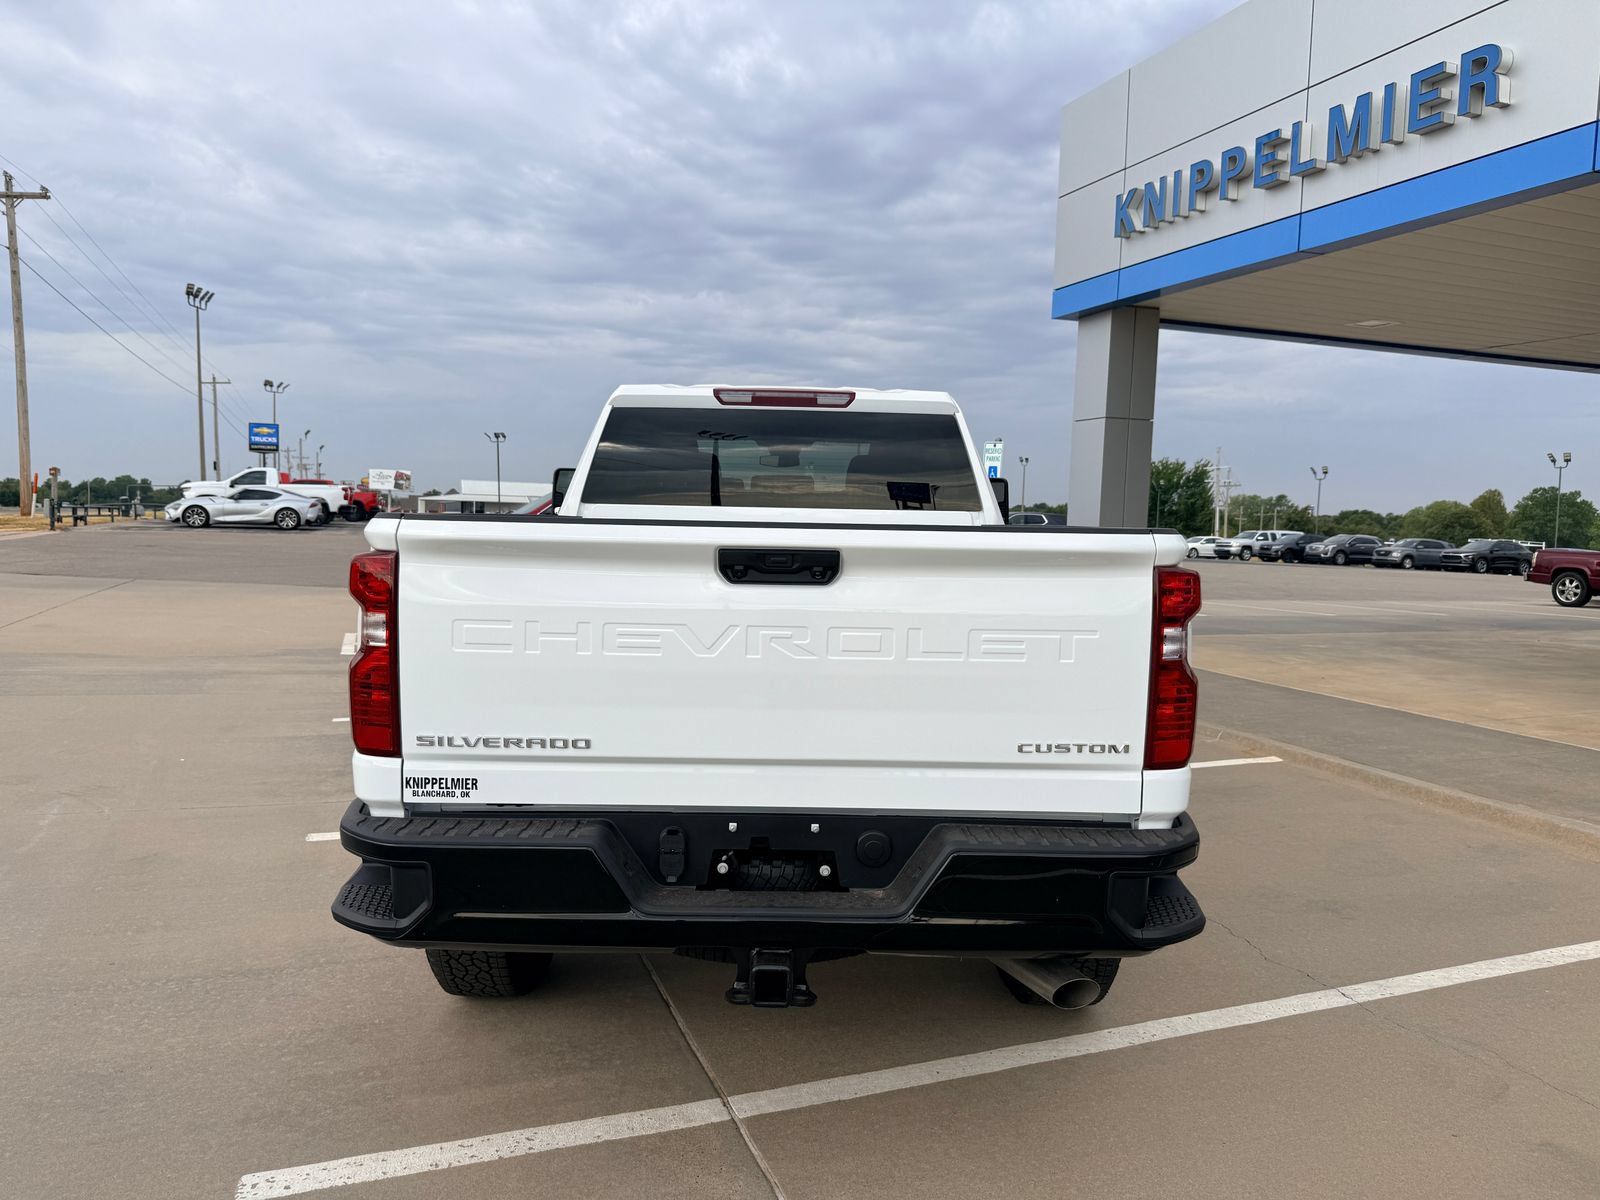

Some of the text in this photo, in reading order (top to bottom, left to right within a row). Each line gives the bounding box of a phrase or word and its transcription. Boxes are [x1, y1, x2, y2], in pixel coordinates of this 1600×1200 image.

[1113, 43, 1514, 238] KNIPPELMIER
[452, 618, 1101, 663] CHEVROLET
[416, 735, 592, 749] SILVERADO
[1017, 743, 1130, 753] CUSTOM
[405, 777, 478, 790] KNIPPELMIER
[412, 790, 459, 799] BLANCHARD,
